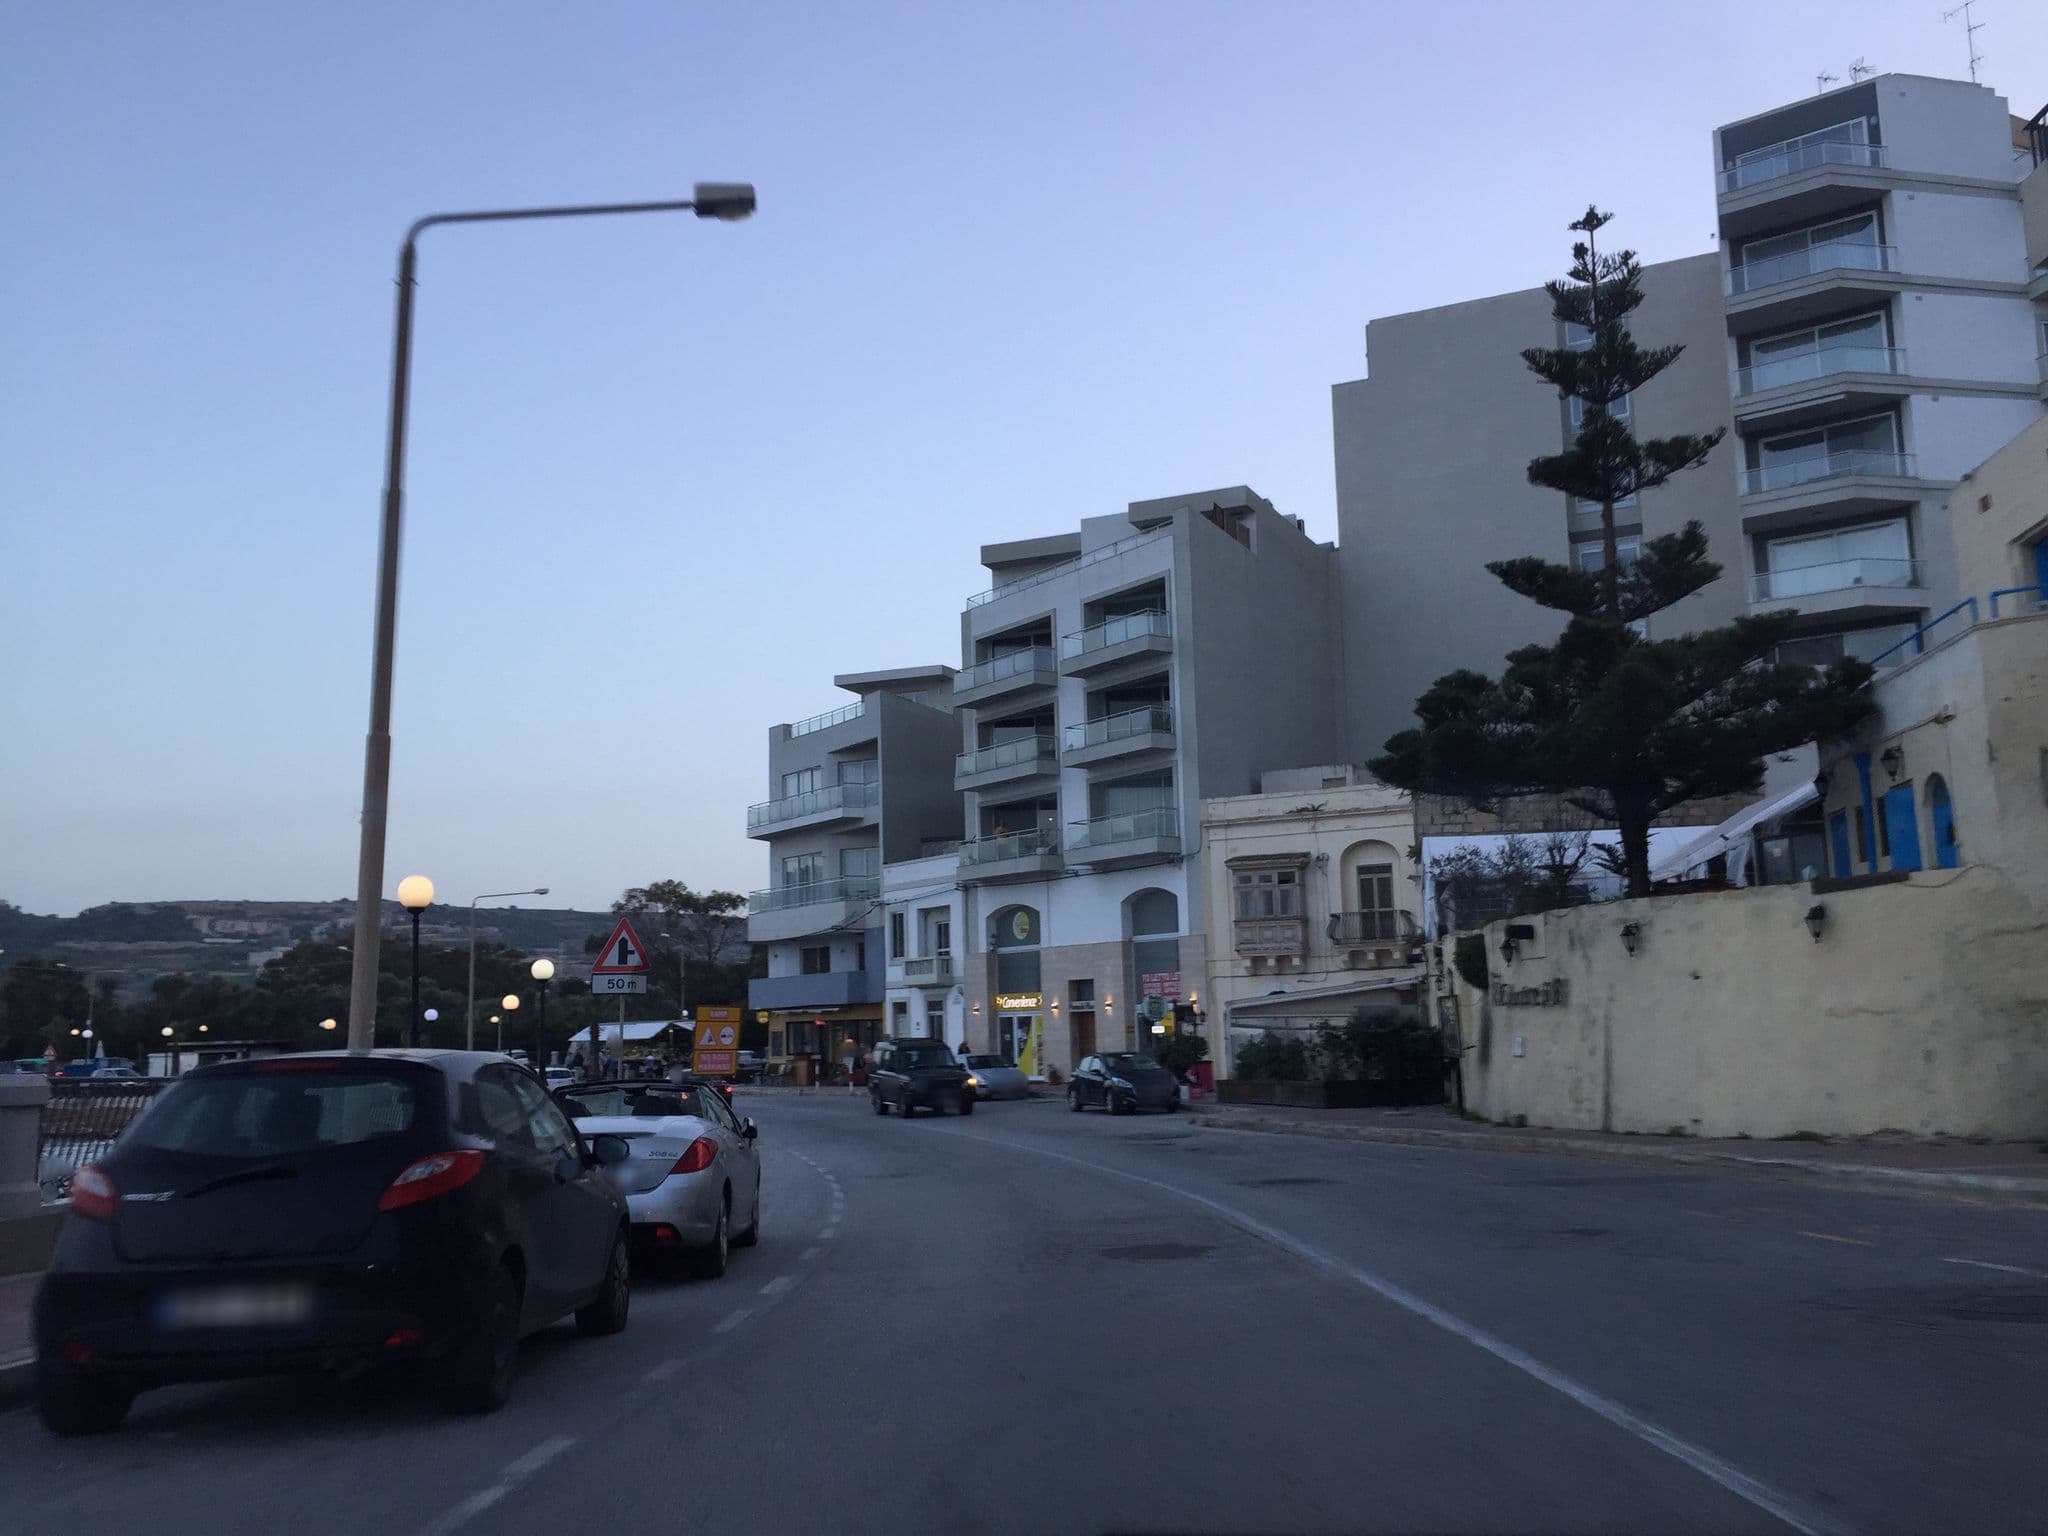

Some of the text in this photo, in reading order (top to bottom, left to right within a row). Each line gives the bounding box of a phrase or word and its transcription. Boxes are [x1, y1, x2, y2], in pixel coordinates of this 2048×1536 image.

[607, 979, 637, 990] 50 m
[1002, 995, 1038, 1009] Convenience
